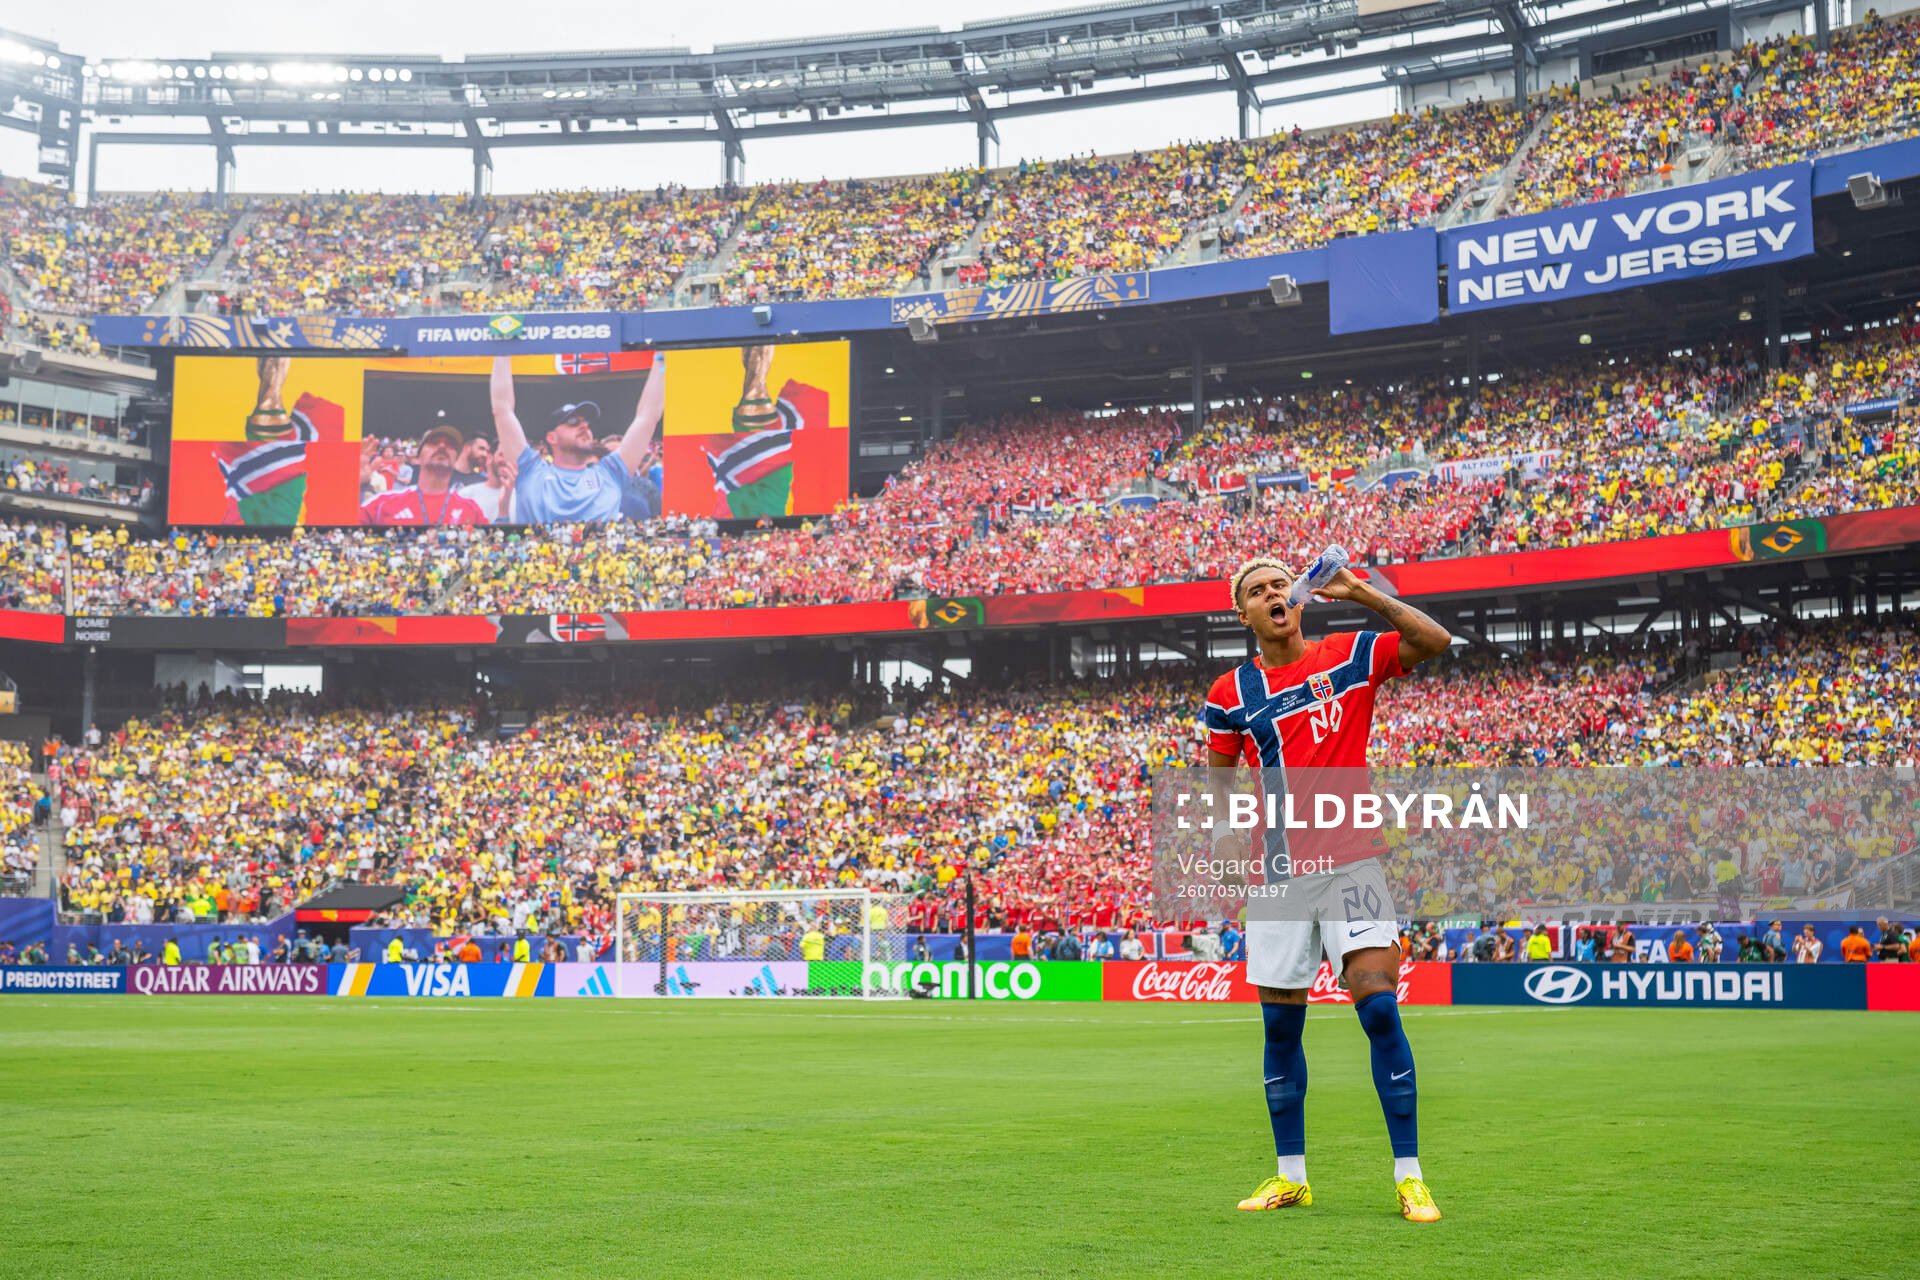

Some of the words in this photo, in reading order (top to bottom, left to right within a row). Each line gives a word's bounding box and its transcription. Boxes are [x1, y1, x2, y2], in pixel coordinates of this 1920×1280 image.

[1458, 218, 1598, 270] NEW
[1612, 179, 1796, 241] YORK
[1458, 262, 1573, 304] NEW
[1584, 221, 1797, 284] JERSEY
[417, 328, 454, 342] FIFA
[518, 326, 550, 340] CUP
[552, 325, 611, 339] 2026
[1480, 460, 1499, 468] FOR
[75, 631, 111, 641] NOISE!
[1341, 884, 1382, 923] 20
[6, 971, 121, 989] PREDICTSTREET
[135, 966, 211, 995] QATAR
[218, 965, 319, 992] AIRWAYS
[400, 963, 471, 997] VISA
[1132, 961, 1237, 1001] Coca-Cola
[1602, 971, 1784, 1001] HYUNDAI
